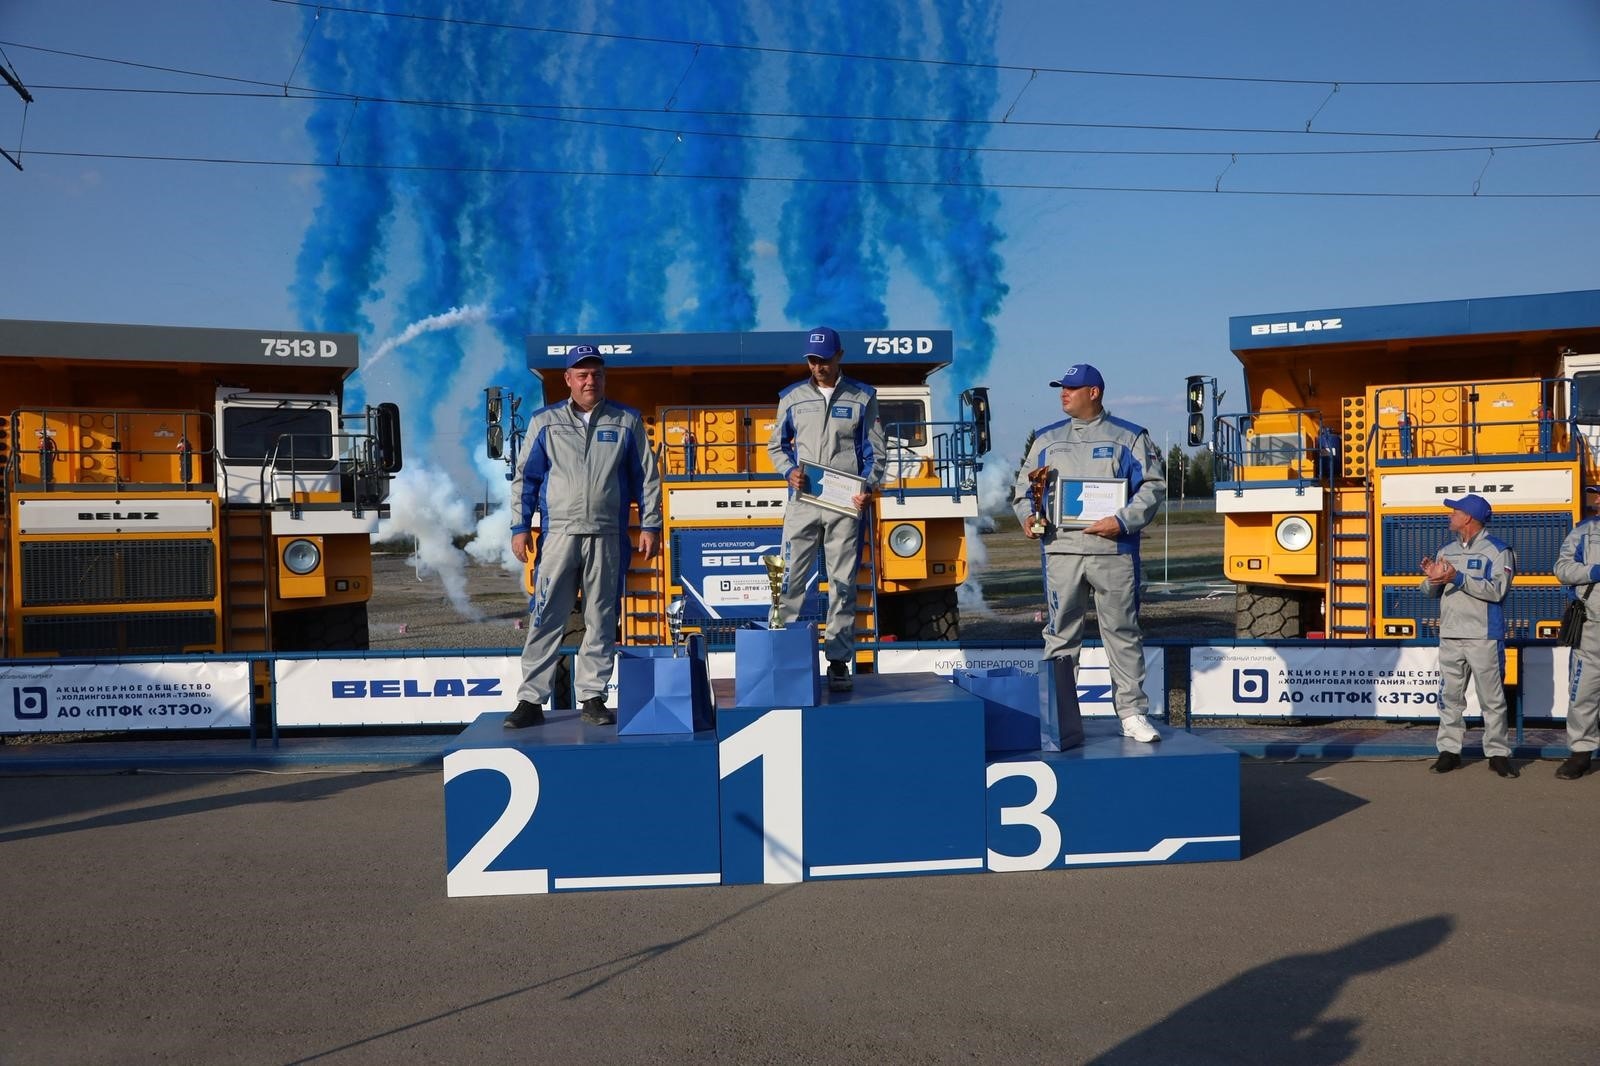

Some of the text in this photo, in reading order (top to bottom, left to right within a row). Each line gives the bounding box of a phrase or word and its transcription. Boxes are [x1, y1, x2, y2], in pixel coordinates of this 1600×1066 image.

[1251, 318, 1343, 335] BELAZ
[261, 338, 338, 357] 7513 D
[547, 344, 632, 355] BAZ
[864, 337, 933, 355] 7513 D
[1435, 484, 1514, 494] BELAZ
[716, 500, 783, 509] BELAZ
[78, 512, 159, 520] BELAZ
[702, 555, 767, 567] BEL
[934, 660, 1034, 669] КЛУБ ОПЕРАТОРОВ
[1379, 670, 1440, 678] ОБЩЕСТВ
[56, 683, 211, 693] АКЦИОНЕРНОЕ ОБЩЕСТВО
[332, 678, 503, 698] BELAZ
[1278, 678, 1352, 686] «ХОЛДИНГОВАЯ
[56, 693, 124, 701] «ХОЛДИНГОВАЯ
[125, 692, 171, 700] КОМПАНИЯ
[1279, 691, 1438, 704] АО «ПТФК «ЗТЭО
[57, 703, 212, 718] АО «ПТФК «ЗТЭО»
[719, 709, 803, 884] 1
[443, 747, 549, 897] 2
[986, 760, 1062, 872] 3
